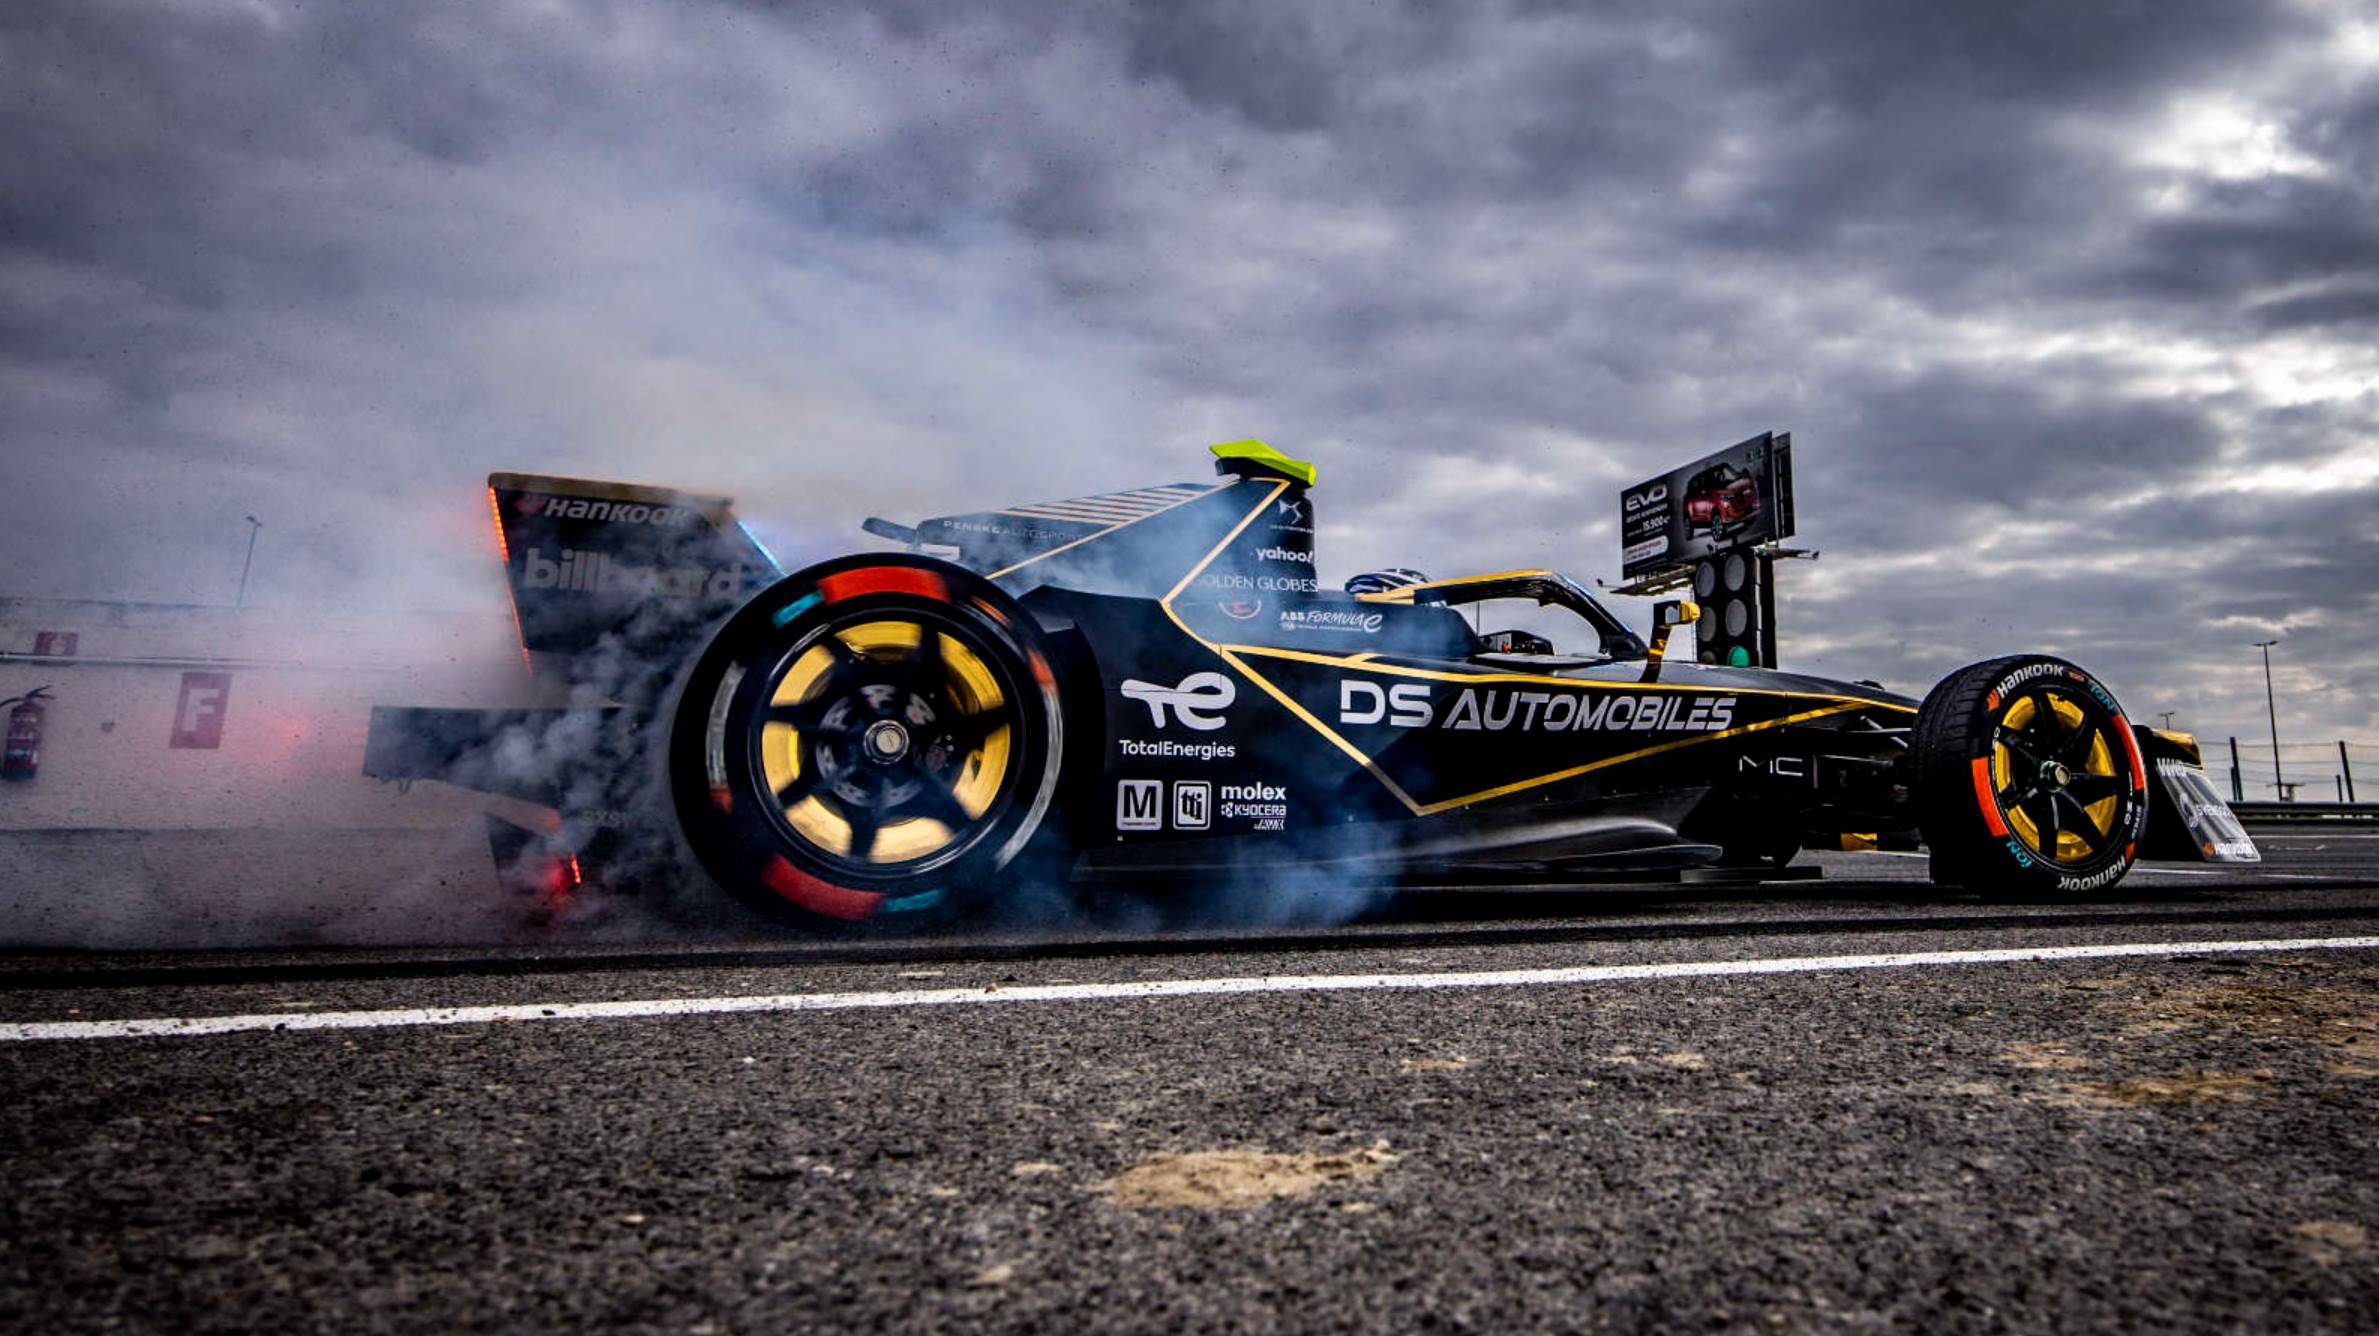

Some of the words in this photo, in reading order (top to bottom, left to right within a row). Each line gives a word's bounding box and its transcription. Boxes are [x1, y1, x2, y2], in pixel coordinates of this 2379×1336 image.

[1626, 484, 1668, 511] EVO
[943, 520, 1000, 534] PENSKE
[1256, 546, 1314, 563] yahoo!
[1257, 576, 1319, 593] GLOBES
[1280, 611, 1305, 621] ABB
[1306, 610, 1365, 626] FORMULA
[182, 688, 219, 732] F
[1340, 679, 1434, 728] DS
[1442, 688, 1736, 731] AUTOMOBILES
[1118, 739, 1236, 760] TotalEnergies
[1220, 781, 1287, 800] molex
[1122, 784, 1157, 818] M
